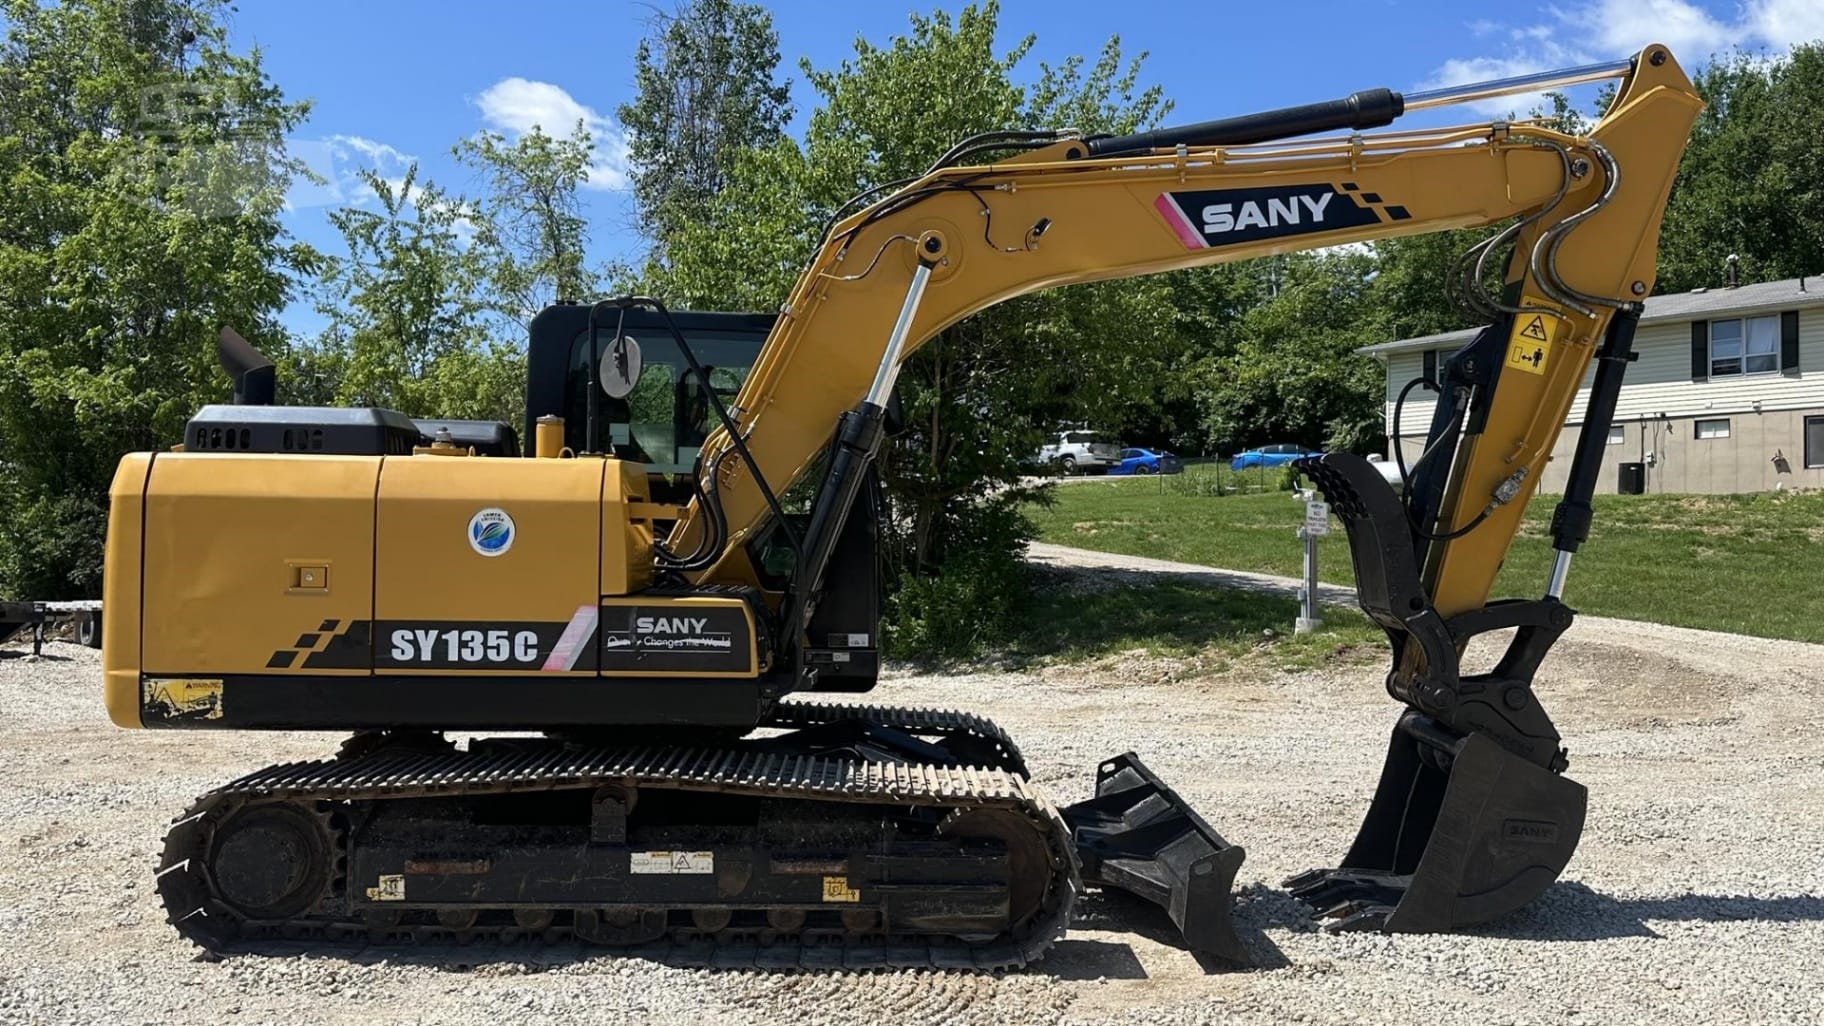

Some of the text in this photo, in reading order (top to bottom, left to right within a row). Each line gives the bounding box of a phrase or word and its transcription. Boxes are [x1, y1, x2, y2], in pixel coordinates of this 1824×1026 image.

[1202, 192, 1334, 234] SANY
[637, 617, 708, 634] SANY
[391, 629, 538, 662] SY135C
[644, 636, 684, 649] Changes
[1510, 825, 1553, 837] SANY
